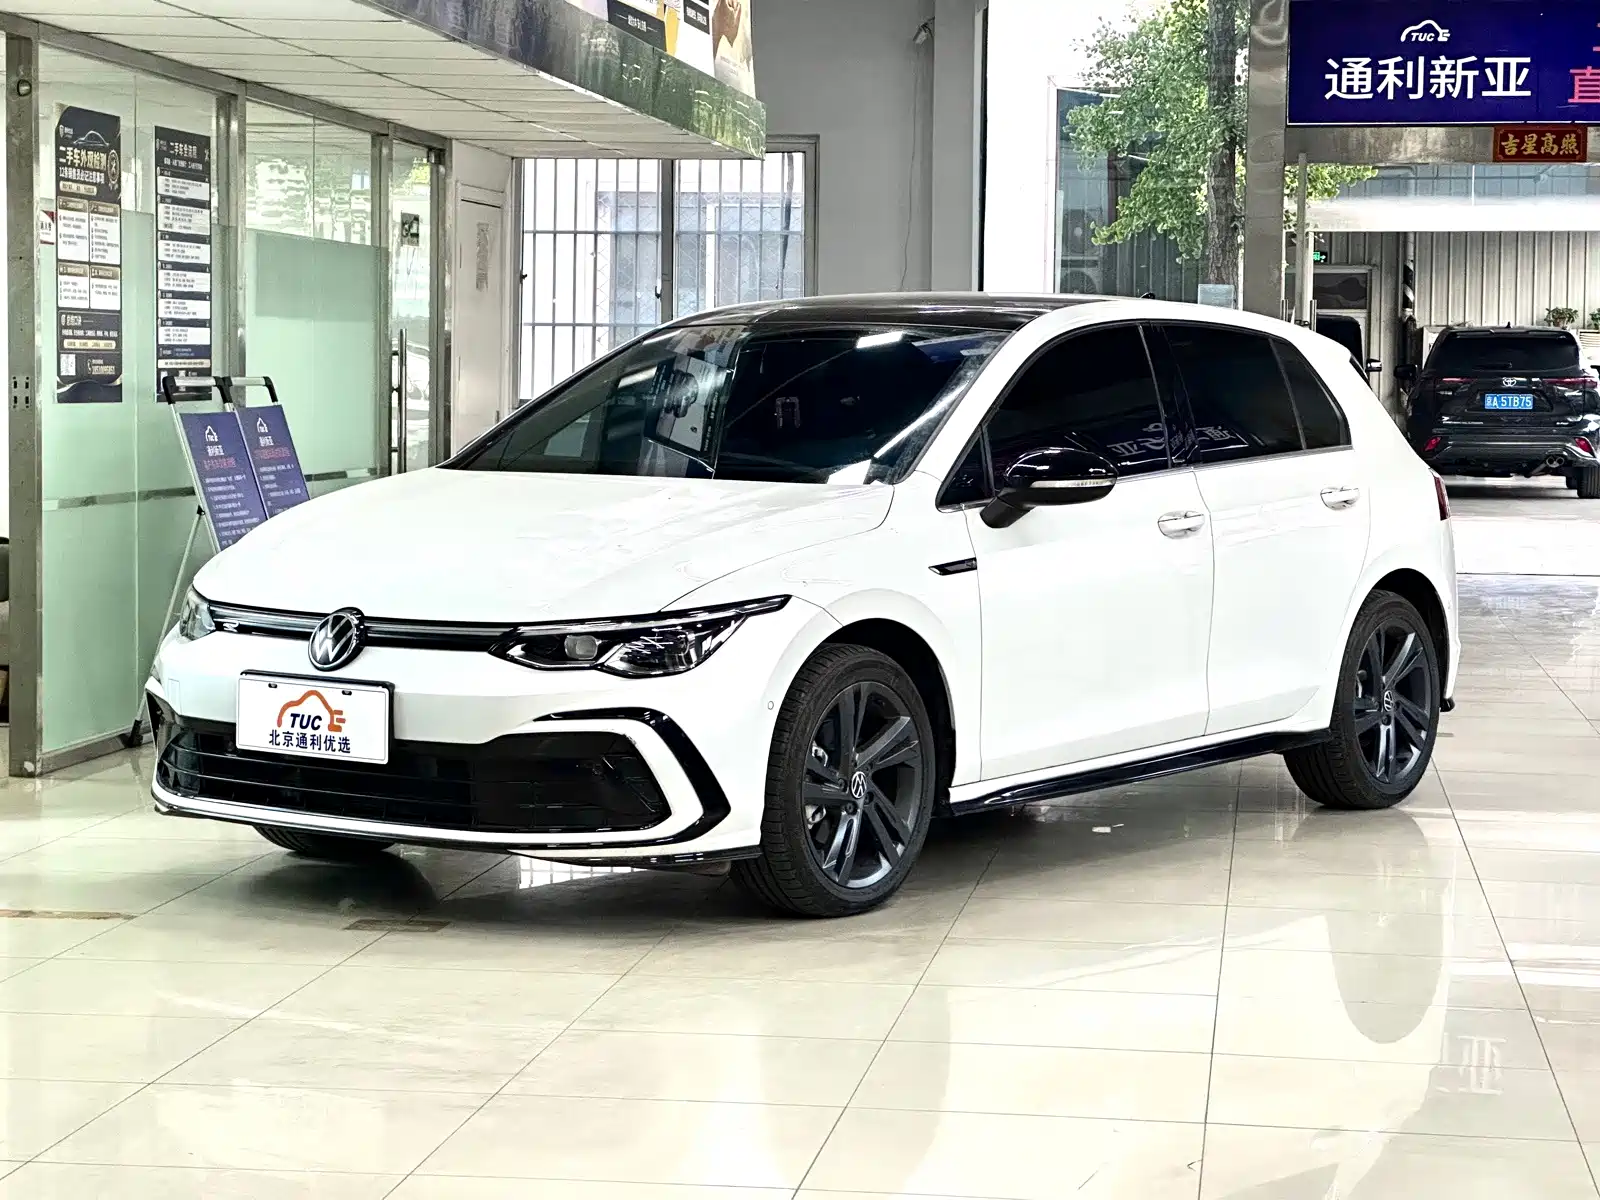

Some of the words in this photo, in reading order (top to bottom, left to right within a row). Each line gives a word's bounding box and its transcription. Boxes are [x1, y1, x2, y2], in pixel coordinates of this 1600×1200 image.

[1324, 55, 1532, 101] 通利新亚
[1568, 65, 1600, 103] 直
[1501, 132, 1579, 155] 吉星高照
[59, 146, 107, 171] 二手车外观检测
[290, 713, 322, 730] TUC
[269, 730, 351, 754] 北京通利优选
